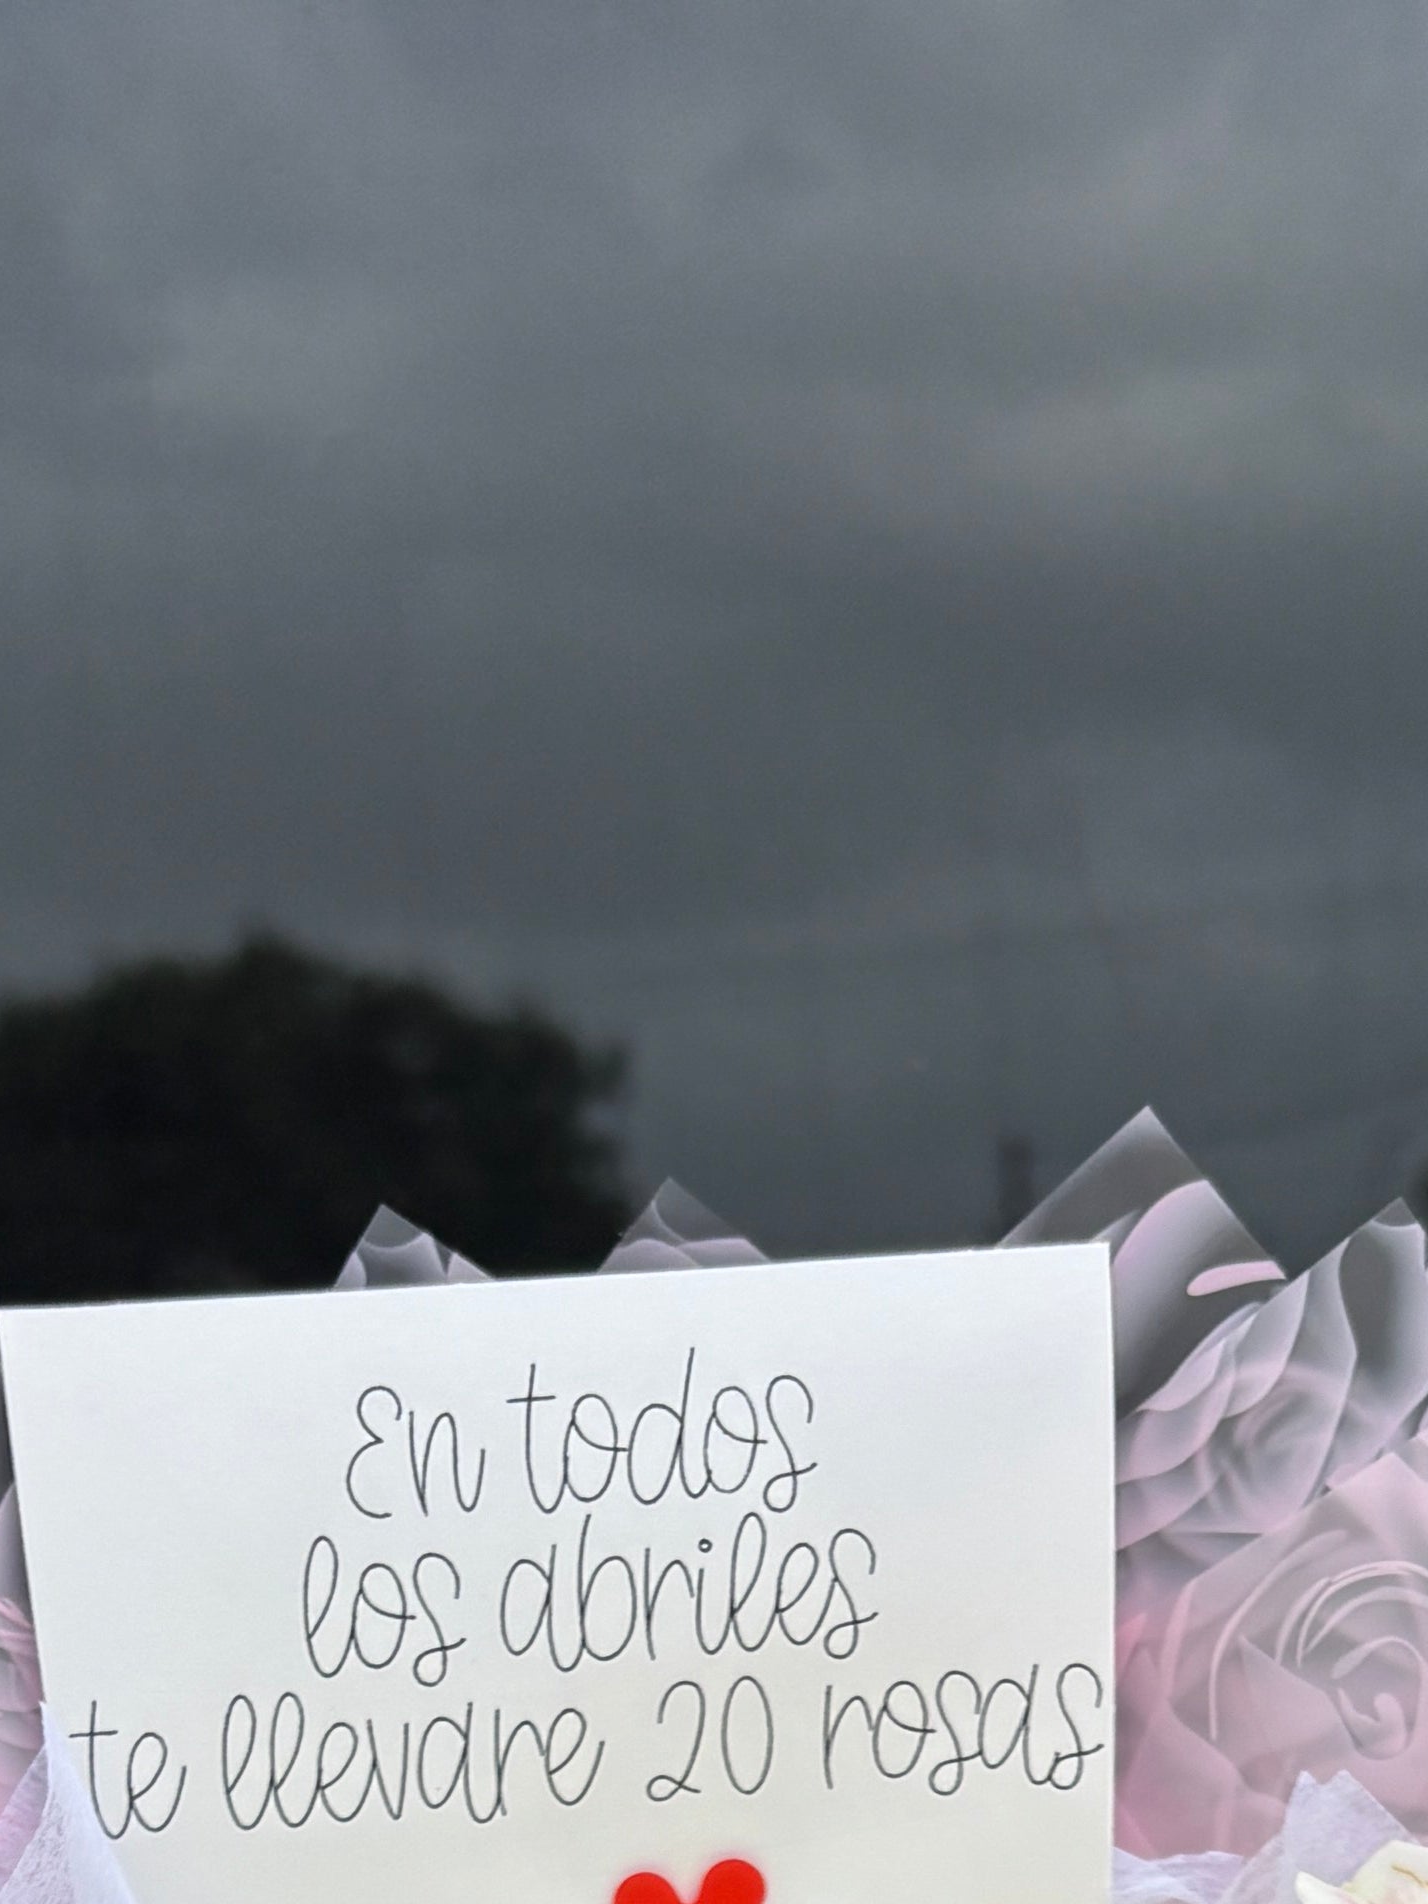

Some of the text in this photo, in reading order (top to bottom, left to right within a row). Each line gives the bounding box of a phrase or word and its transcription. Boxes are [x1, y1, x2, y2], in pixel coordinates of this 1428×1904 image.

[344, 1345, 820, 1520] En todos
[301, 1510, 881, 1689] los abriles
[66, 1661, 1106, 1842] te llevare 20 rosas
